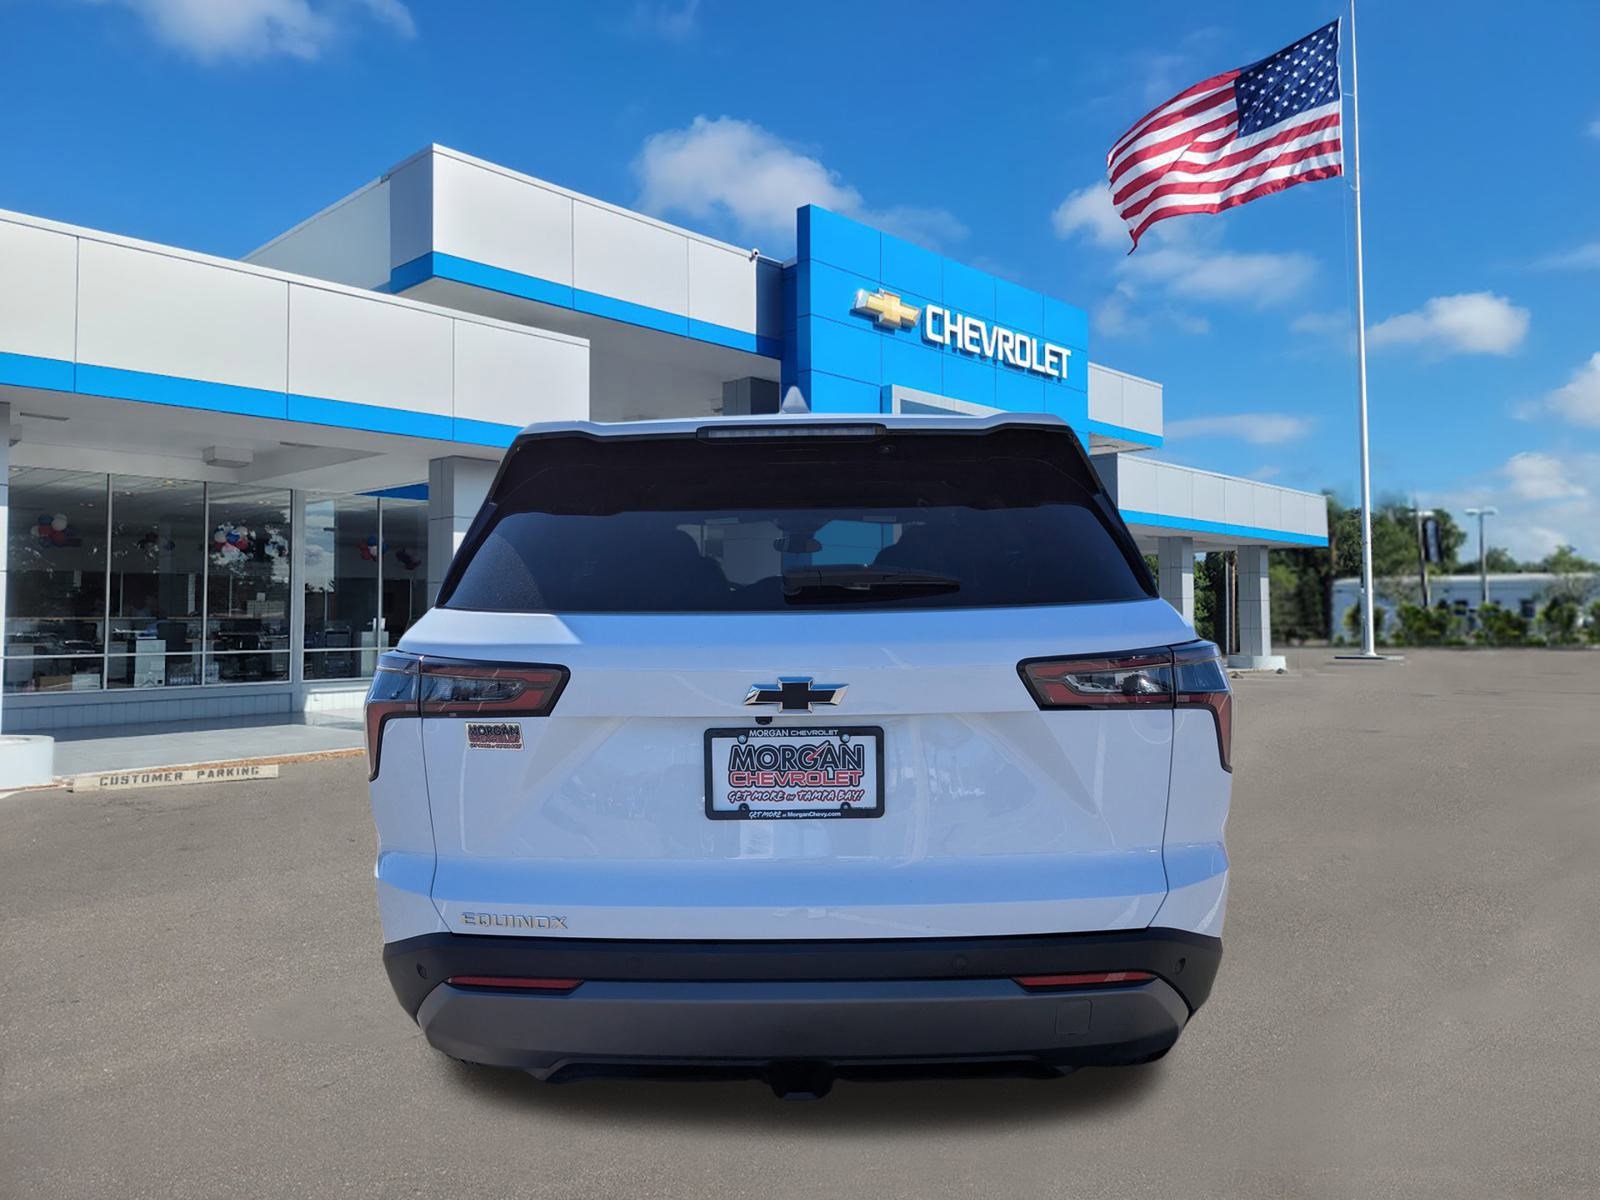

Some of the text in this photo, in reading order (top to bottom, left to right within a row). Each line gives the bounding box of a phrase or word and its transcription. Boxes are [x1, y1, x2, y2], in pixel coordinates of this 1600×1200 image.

[924, 303, 1072, 380] CHEVROLET
[749, 729, 789, 737] MORGAN
[729, 741, 864, 771] MORGAN
[99, 765, 260, 787] CUSTOMER PARKING
[730, 771, 863, 787] CHEVROLET
[728, 791, 750, 803] GET
[750, 790, 785, 801] MORE
[797, 790, 835, 801] TAMPA
[836, 789, 865, 801] BAY!
[461, 911, 569, 930] EQUINOX
